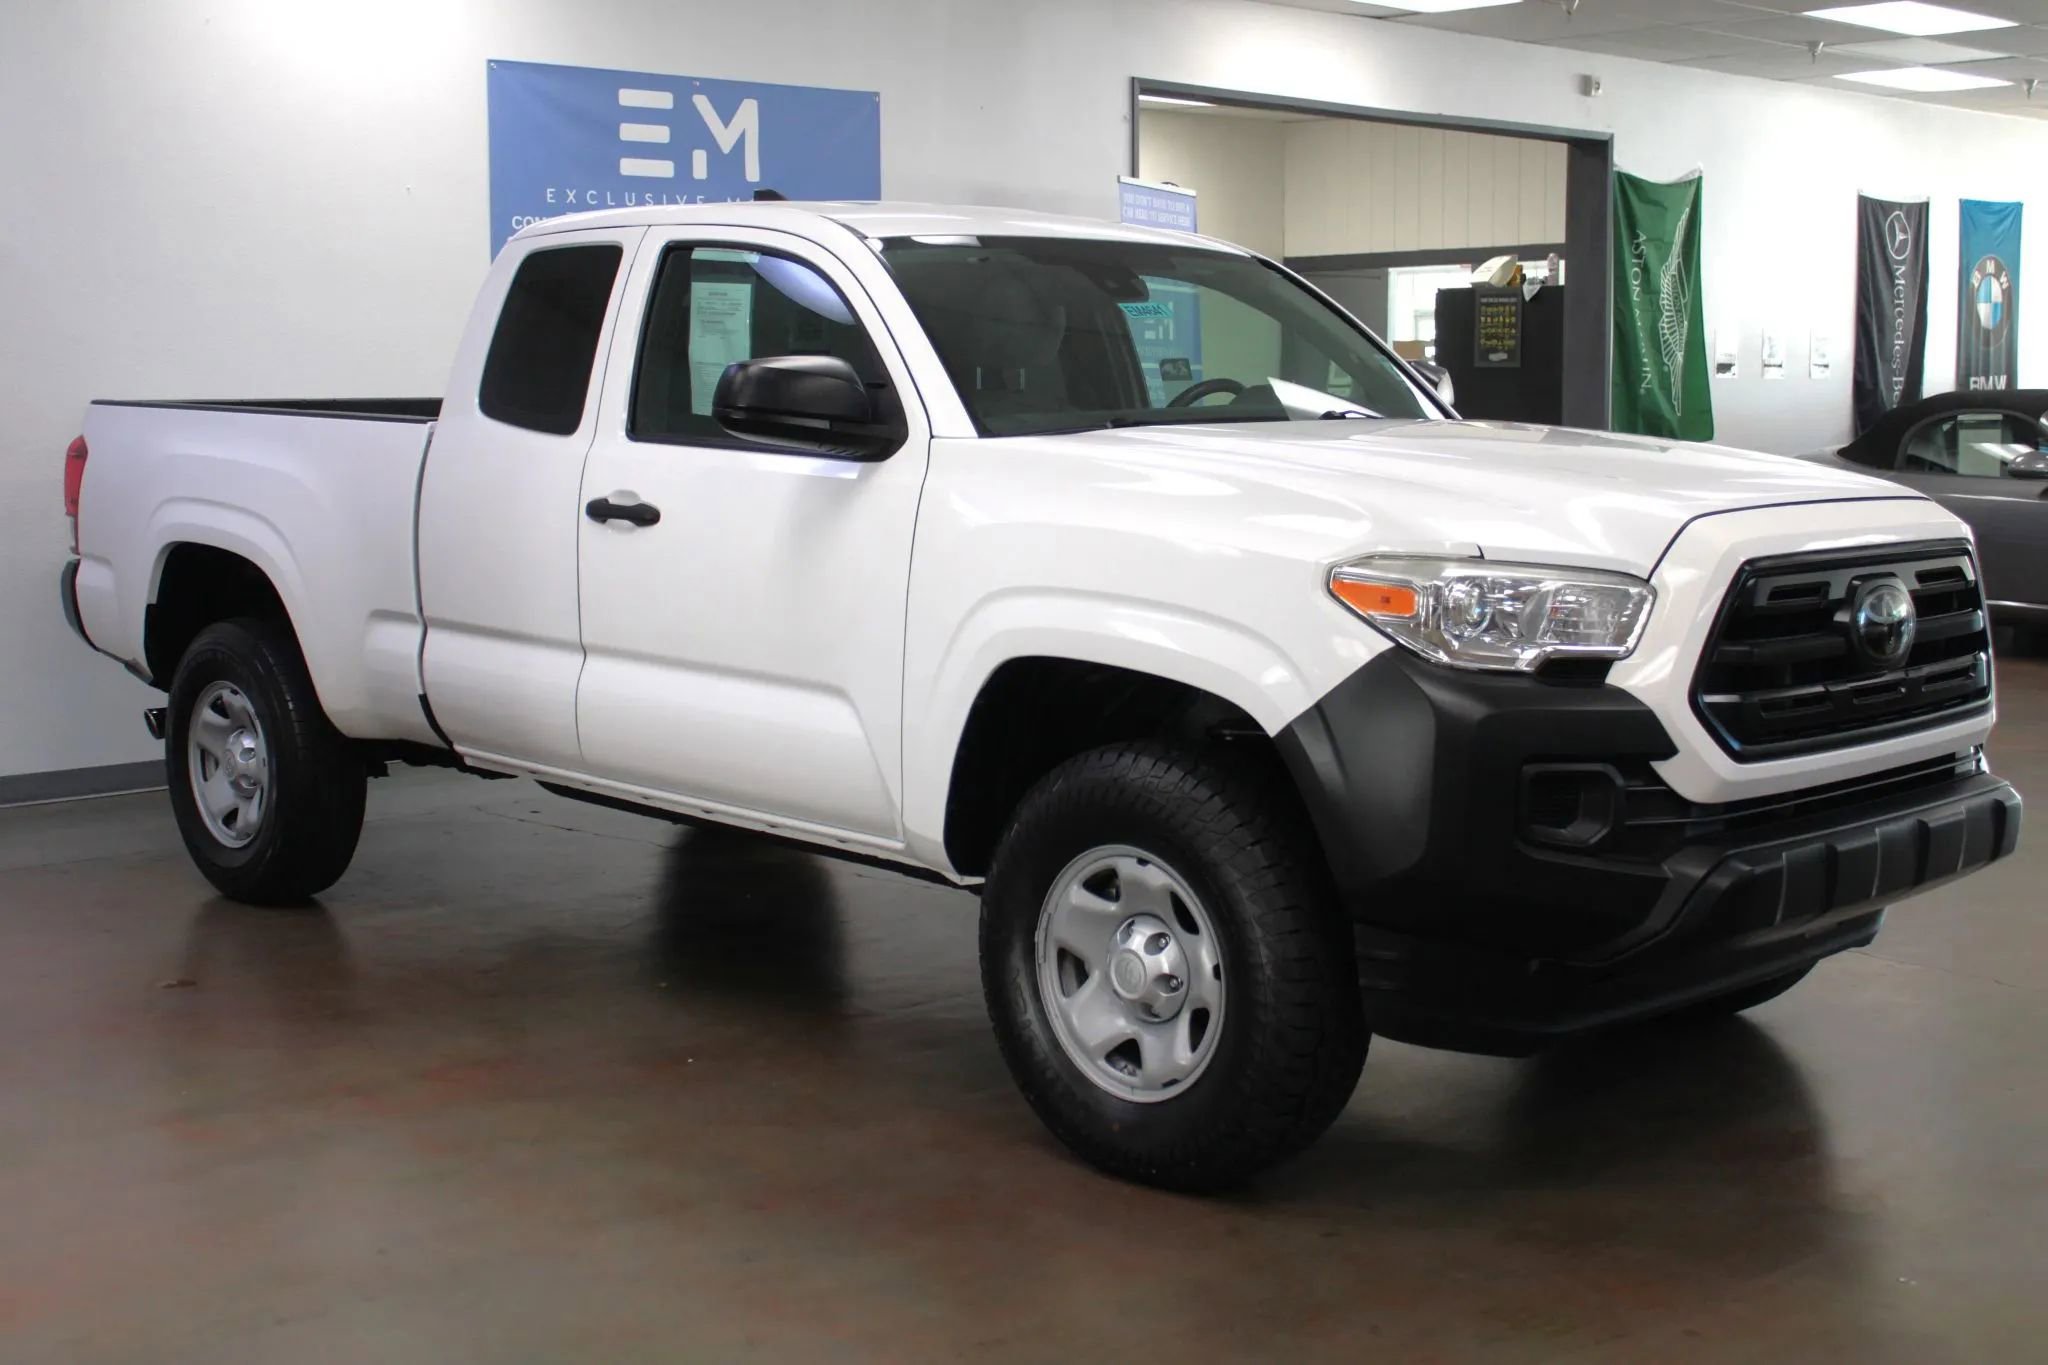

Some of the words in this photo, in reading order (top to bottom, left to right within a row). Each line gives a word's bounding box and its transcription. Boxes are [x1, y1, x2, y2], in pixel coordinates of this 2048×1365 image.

[618, 88, 760, 183] EM
[546, 188, 705, 206] EXCLUSIVE
[1631, 230, 1647, 301] ASTON
[1891, 264, 1906, 409] Mercedes-Be
